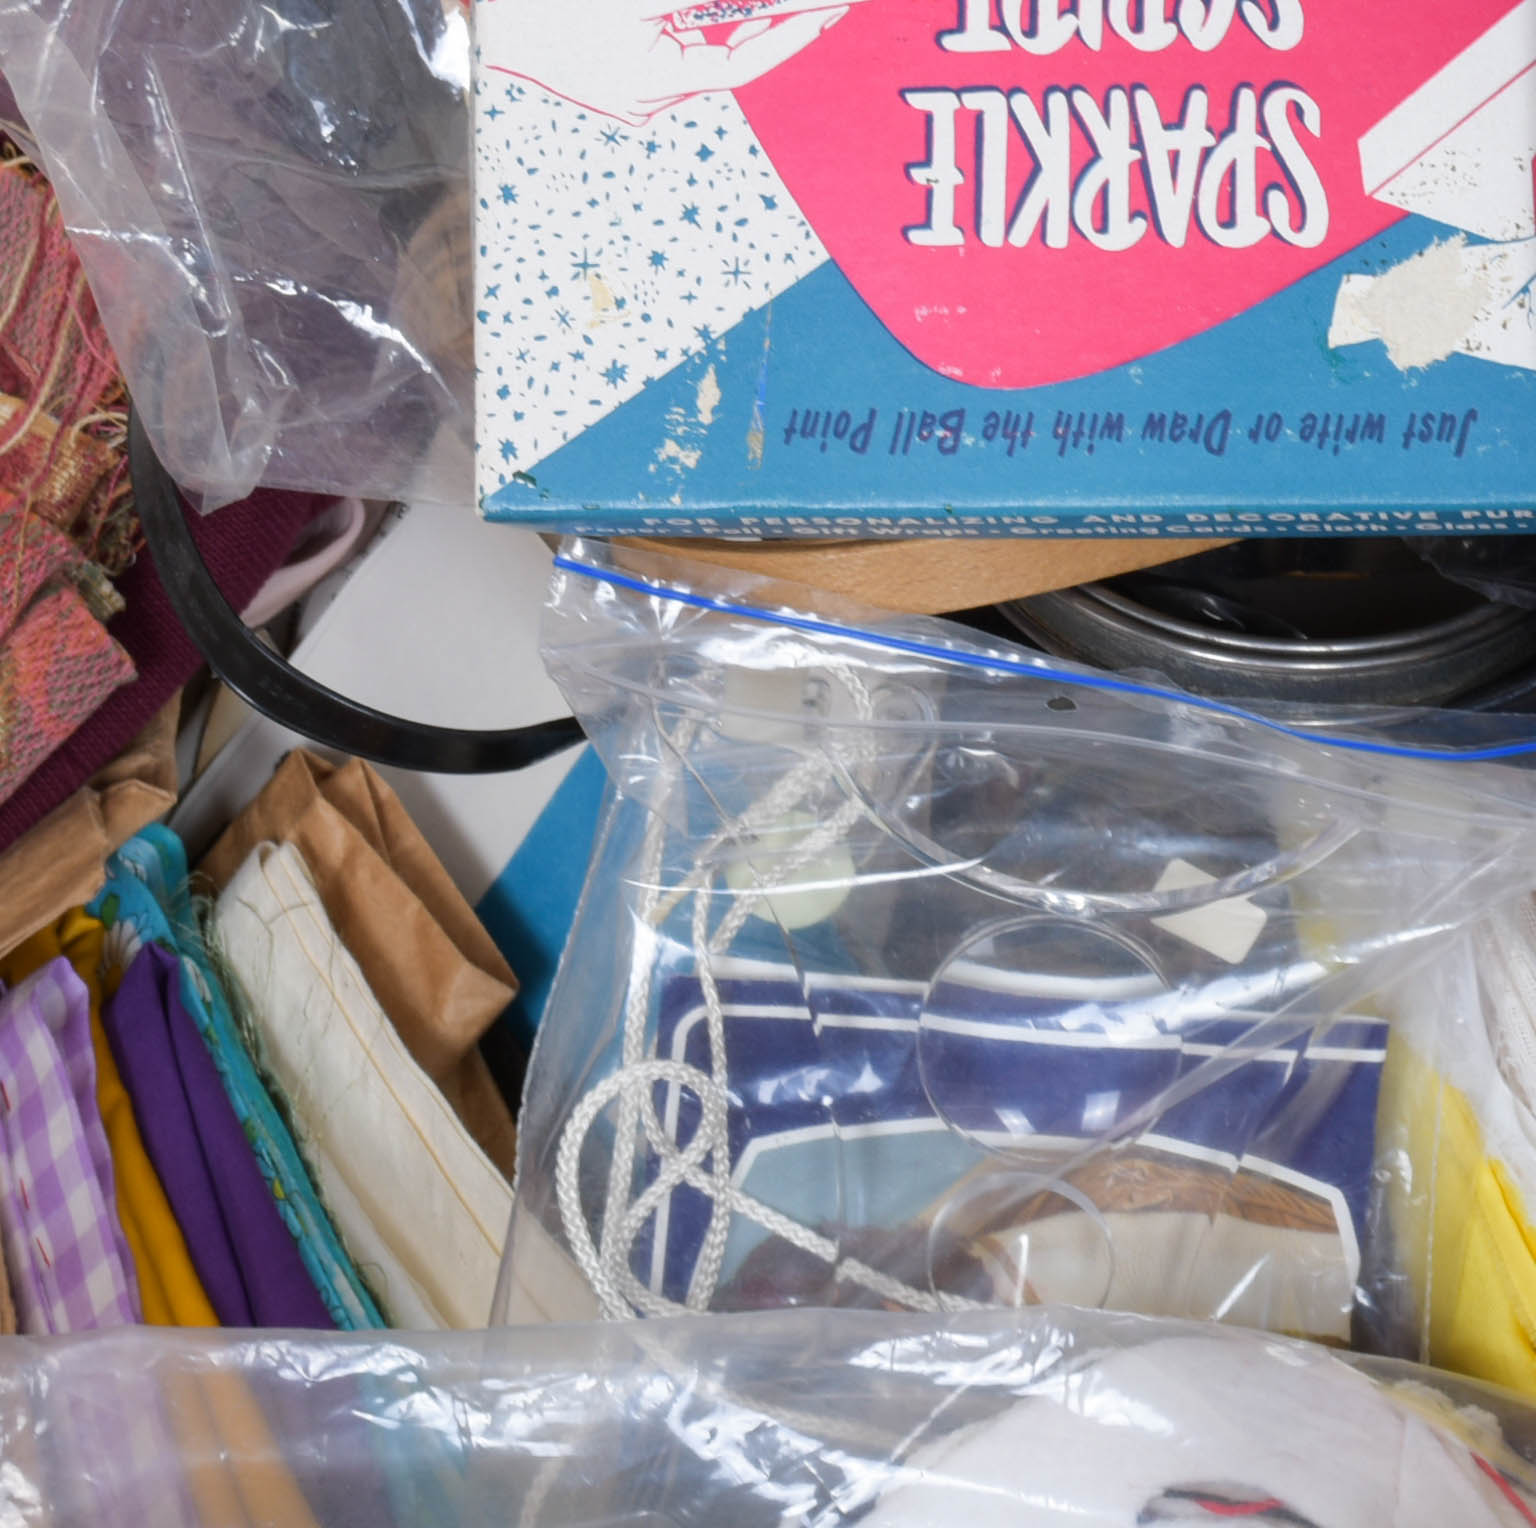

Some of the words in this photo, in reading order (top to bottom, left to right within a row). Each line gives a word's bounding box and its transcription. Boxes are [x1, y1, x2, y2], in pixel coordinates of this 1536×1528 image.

[899, 80, 1330, 251] SPARKLE
[783, 408, 877, 455] Point
[888, 407, 967, 456] Ball
[982, 409, 1034, 457] the
[1052, 409, 1124, 457] with
[1140, 408, 1233, 456] Draw
[1248, 412, 1283, 444] or
[1300, 412, 1386, 456] write
[1402, 407, 1478, 458] Just
[642, 516, 720, 527] FOR
[739, 515, 1059, 526] PERSONALIZING
[1082, 514, 1165, 524] AND
[1186, 511, 1439, 523] DECORATIVE
[868, 526, 981, 537] Wraps
[1010, 525, 1160, 537] Greeting
[1165, 523, 1268, 534] Cards
[1296, 522, 1389, 533] Cloth
[1413, 520, 1509, 532] Glass
